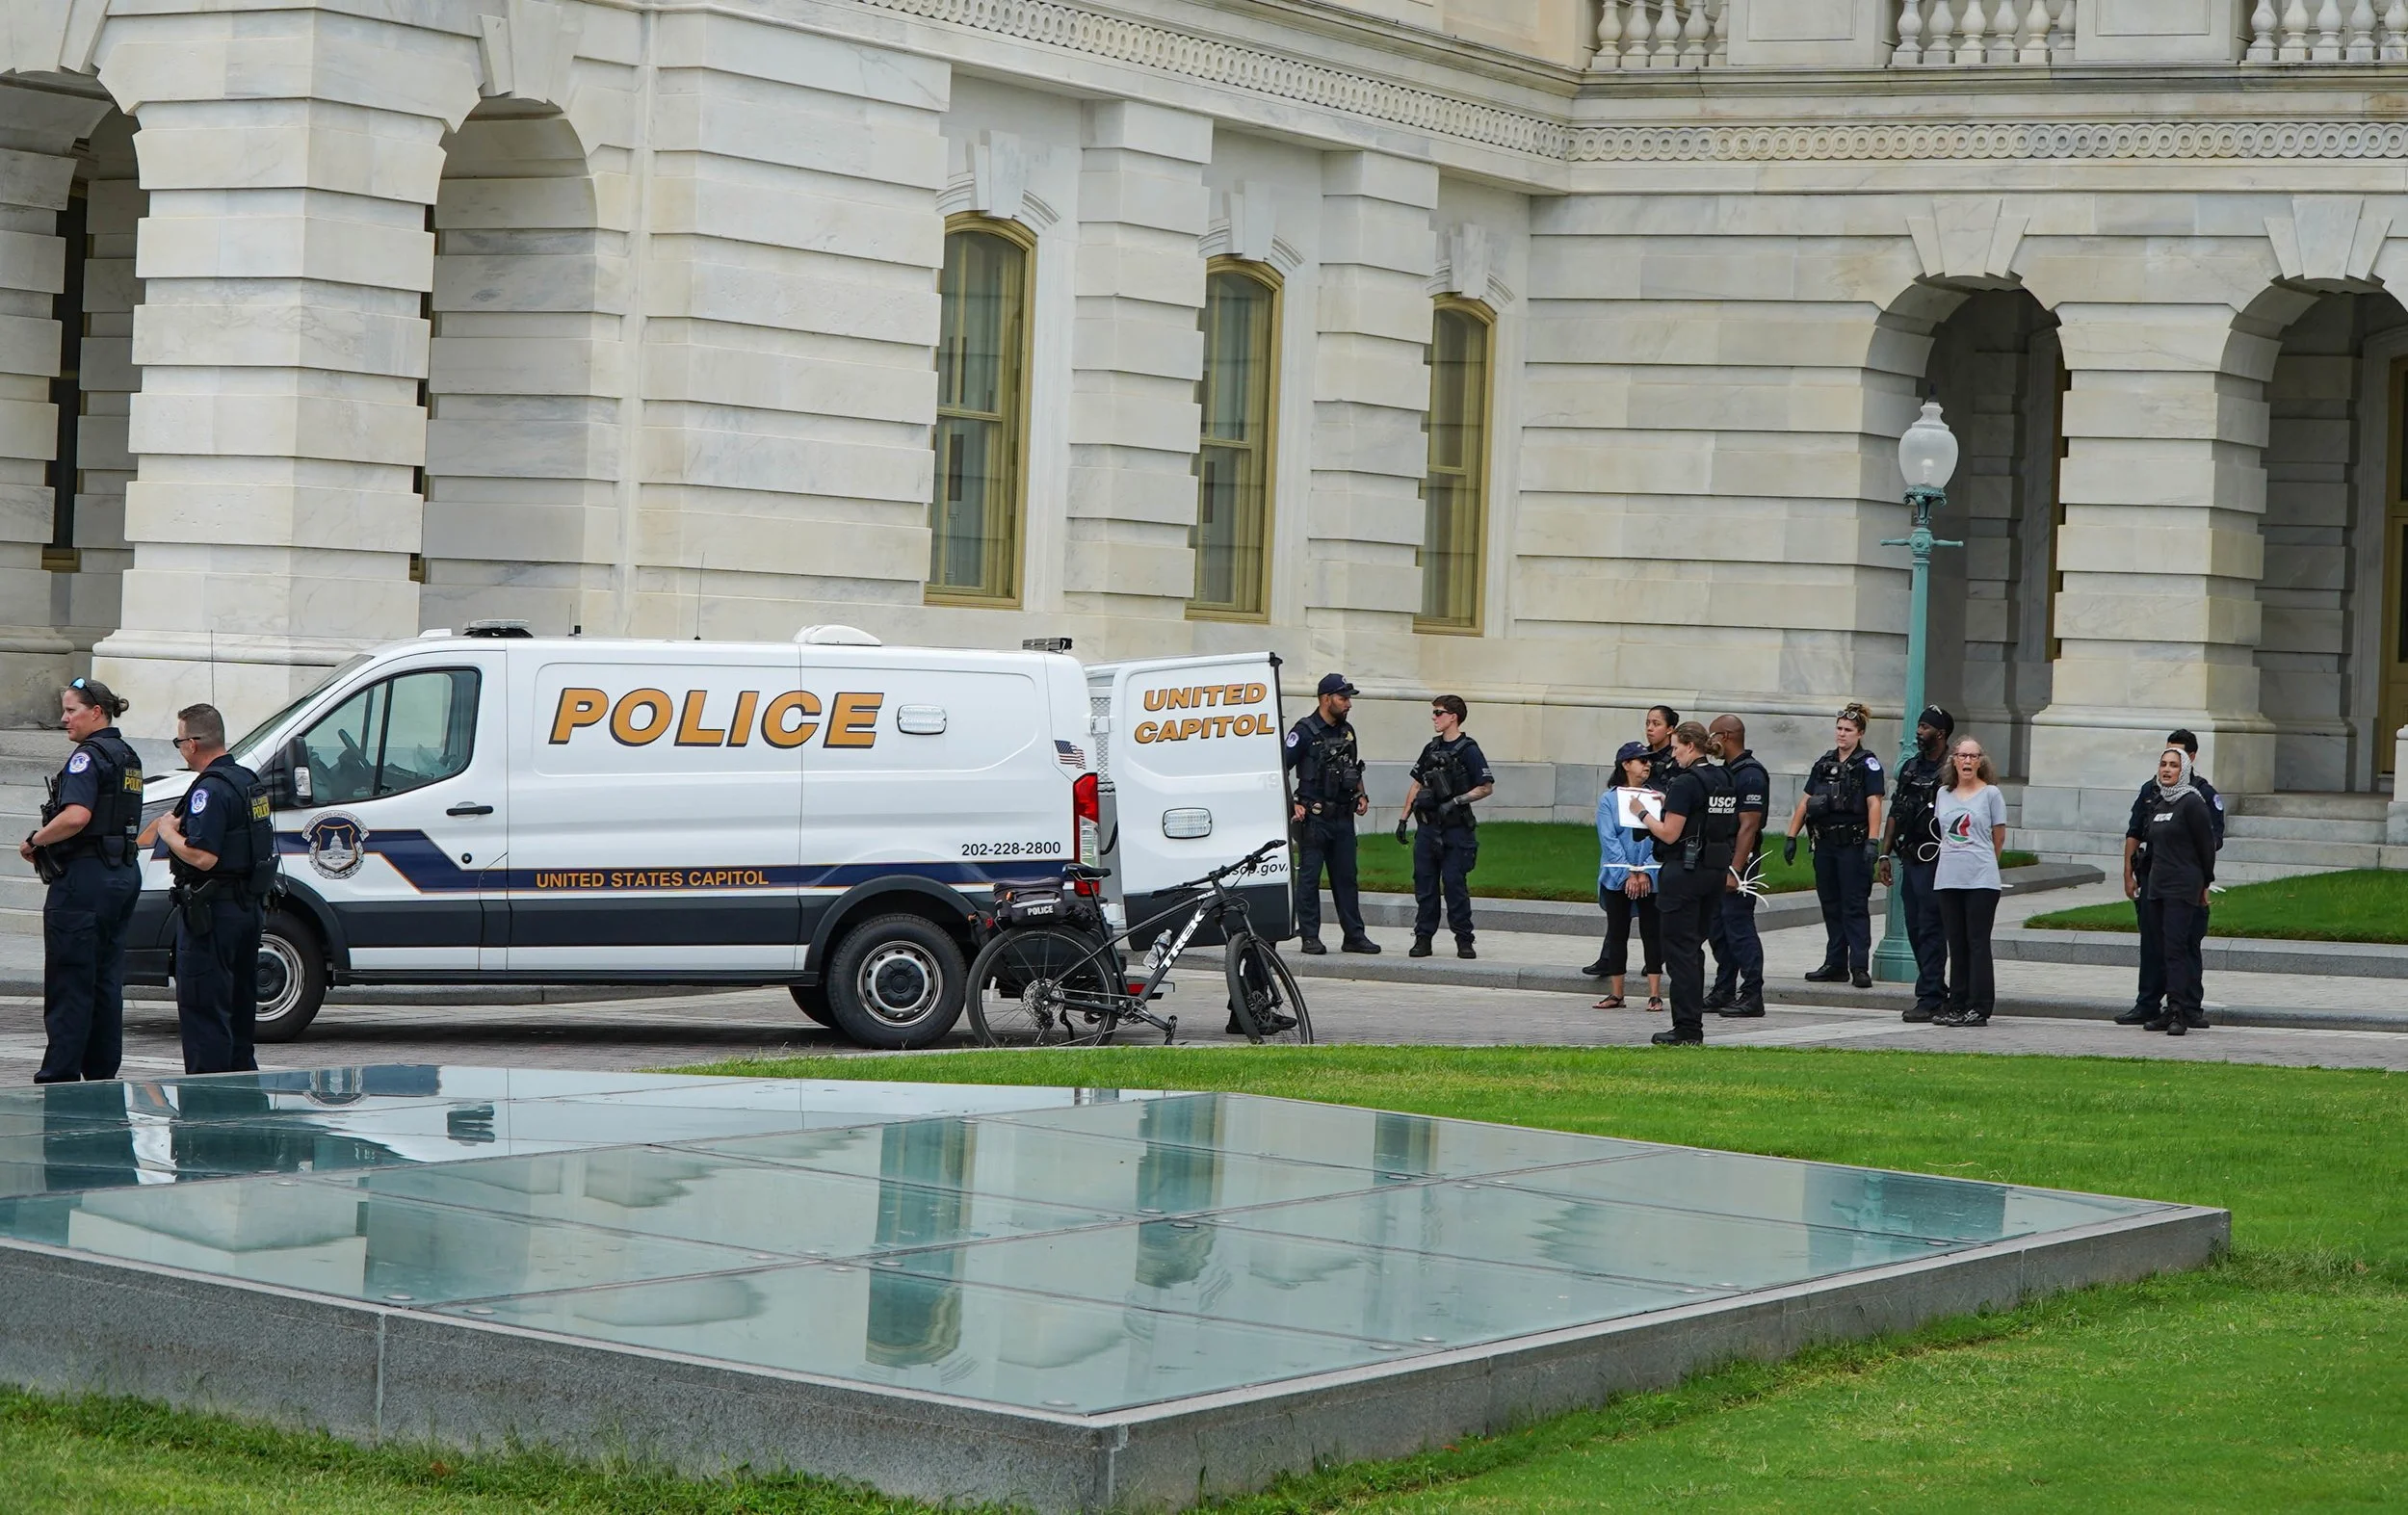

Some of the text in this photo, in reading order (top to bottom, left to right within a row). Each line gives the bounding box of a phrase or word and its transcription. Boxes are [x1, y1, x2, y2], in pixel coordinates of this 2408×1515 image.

[1143, 682, 1268, 712] UNITED
[548, 687, 884, 749] POLICE
[1134, 713, 1275, 744] CAPITOL
[1709, 796, 1737, 808] USCP
[961, 841, 1061, 856] 202-228-2800
[536, 870, 770, 888] UNITED STATES CAPITOL
[1027, 905, 1054, 916] POLICE
[1159, 909, 1206, 968] TREK
